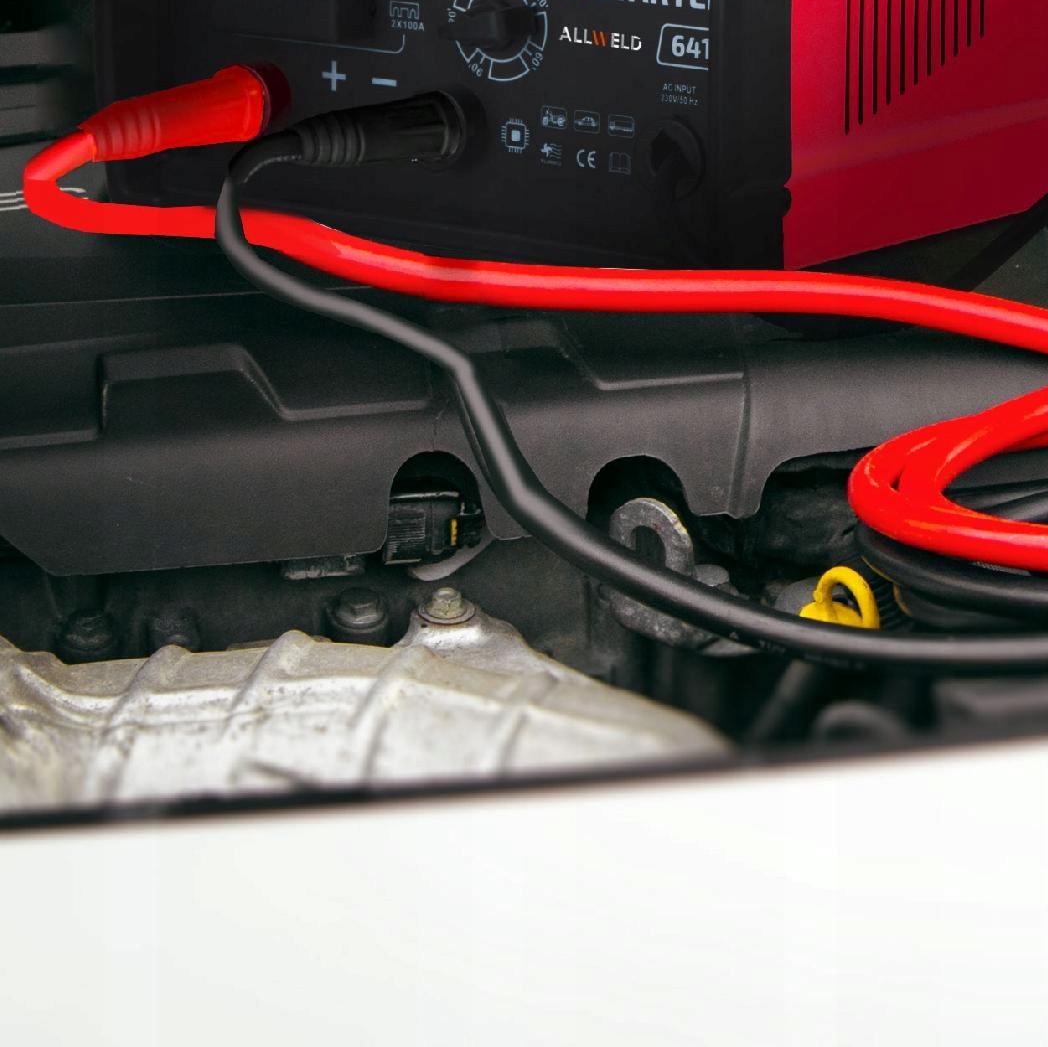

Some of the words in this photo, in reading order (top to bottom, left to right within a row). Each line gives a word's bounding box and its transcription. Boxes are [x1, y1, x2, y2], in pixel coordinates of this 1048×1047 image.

[558, 26, 642, 51] ALLWELD
[662, 83, 673, 92] AC
[674, 83, 697, 95] INPUT
[576, 149, 597, 168] CE
